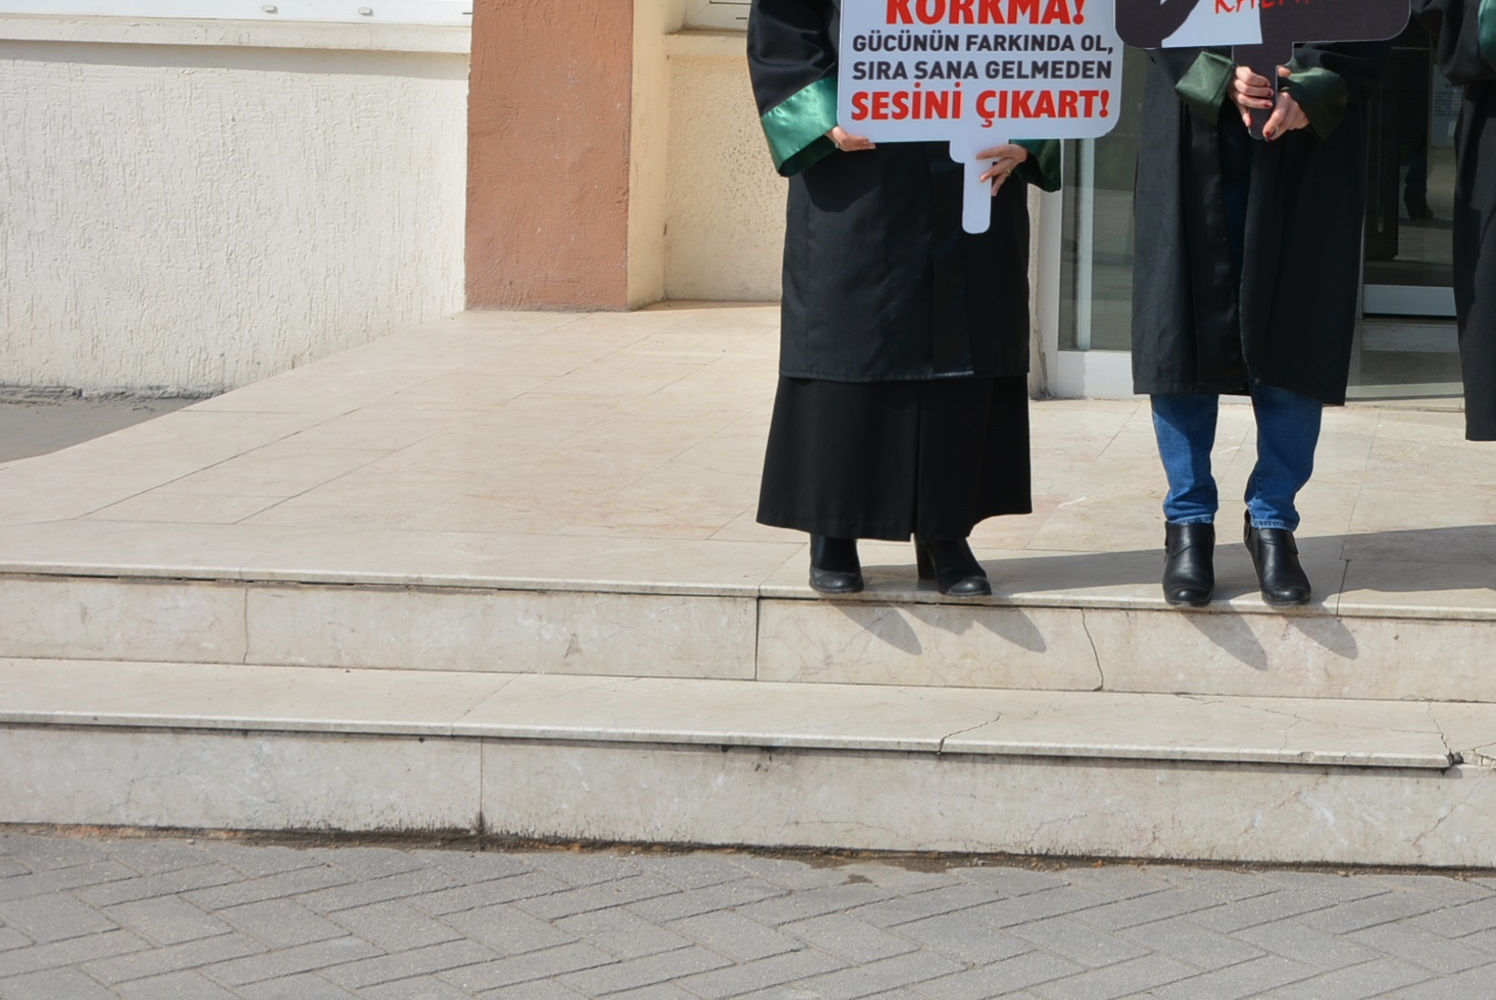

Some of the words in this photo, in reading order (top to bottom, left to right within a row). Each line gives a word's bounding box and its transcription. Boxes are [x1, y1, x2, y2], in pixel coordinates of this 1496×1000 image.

[852, 29, 960, 53] GÜCÜNÜN
[966, 33, 1075, 52] FARKINDA
[1080, 34, 1114, 56] OL,
[852, 61, 909, 81] SIRA
[913, 60, 979, 80] SANA
[984, 60, 1112, 80] GELMEDEN
[850, 81, 963, 121] SESİNİ
[975, 88, 1110, 128] ÇIKART!
